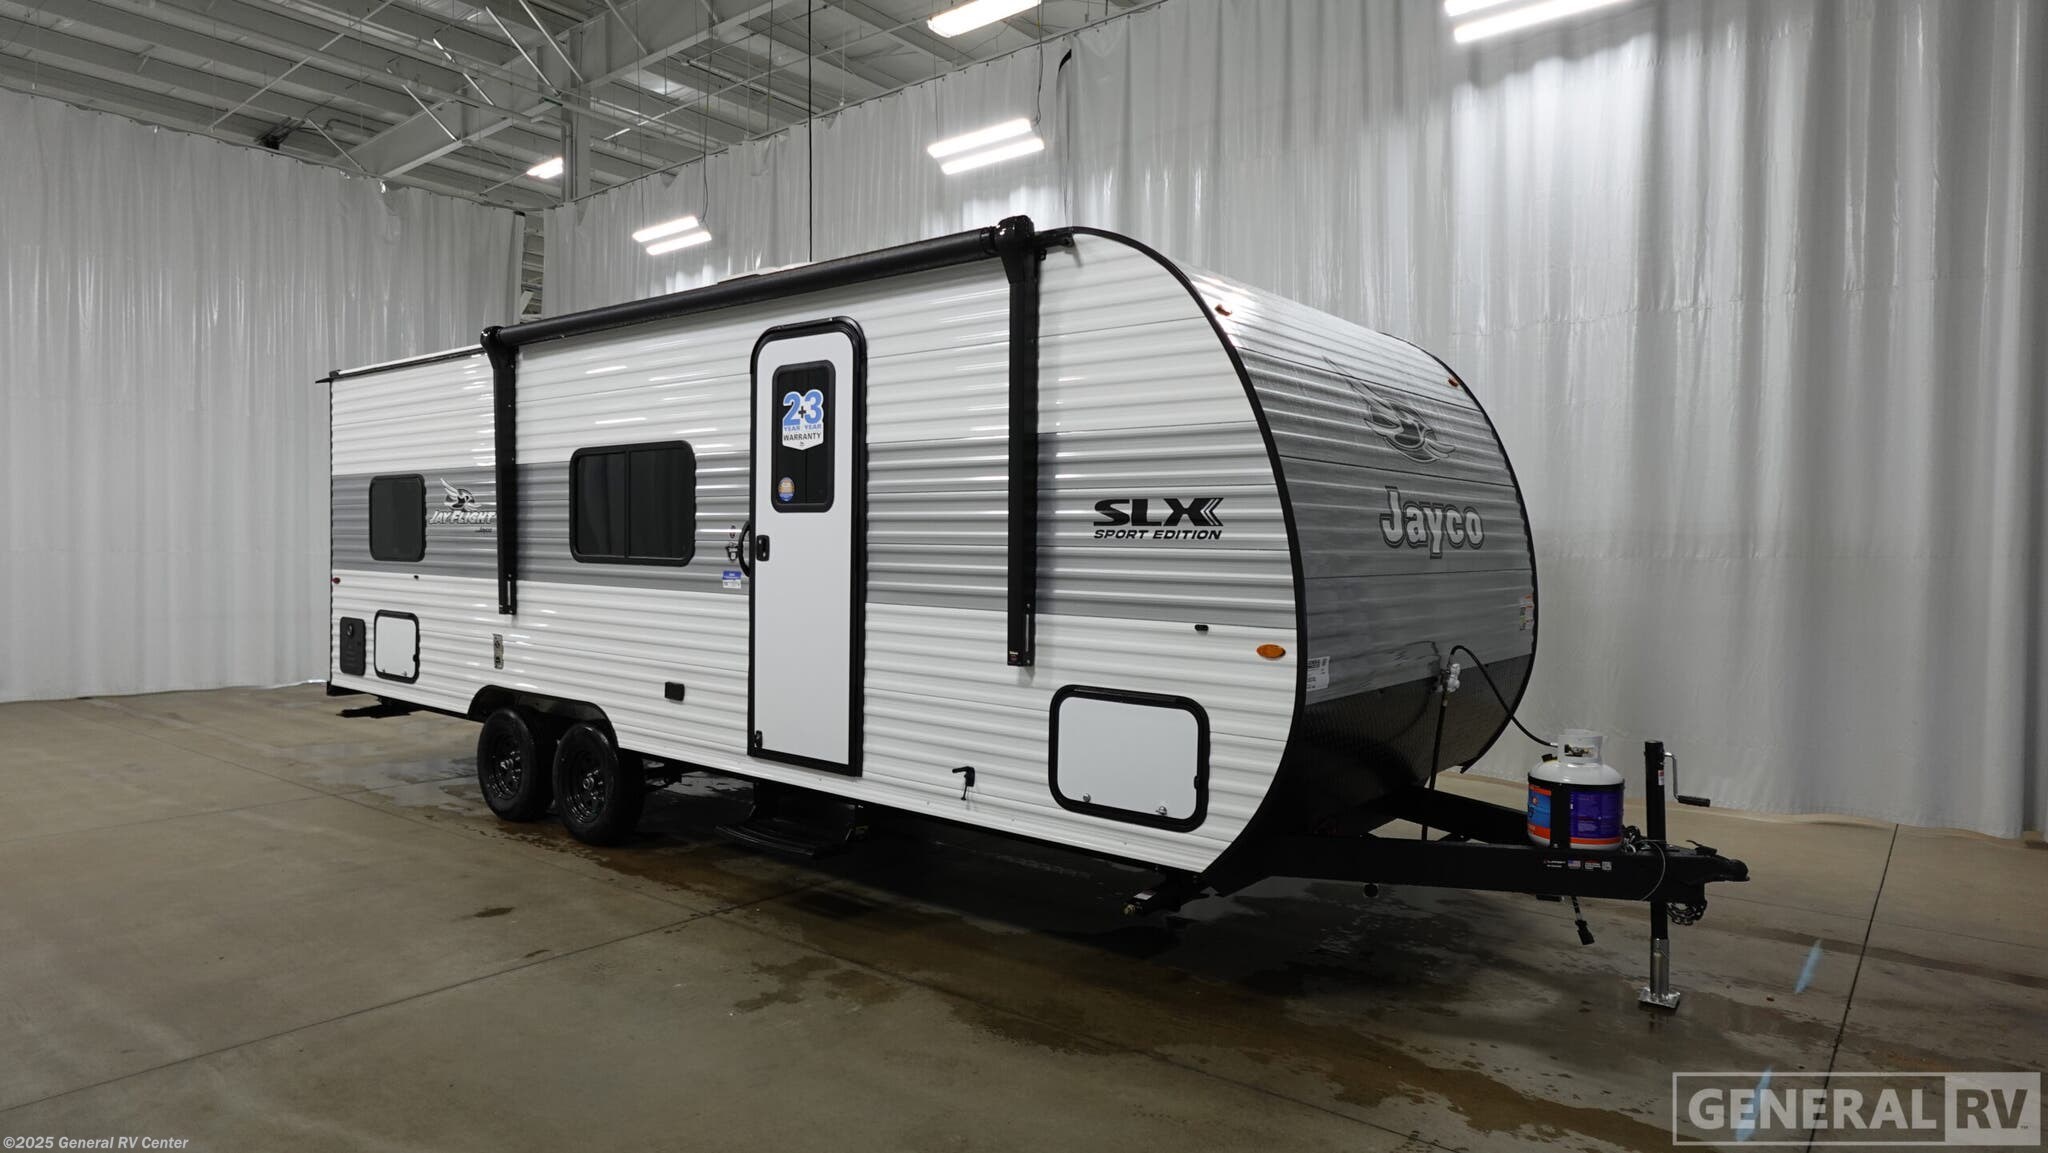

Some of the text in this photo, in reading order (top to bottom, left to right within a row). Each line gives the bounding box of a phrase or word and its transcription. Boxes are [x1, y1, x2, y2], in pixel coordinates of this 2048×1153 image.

[783, 432, 822, 441] WARRANTY
[429, 510, 497, 524] JAY FLIGHT
[1380, 485, 1484, 559] Jayco
[1094, 529, 1222, 540] SPORT EDITION
